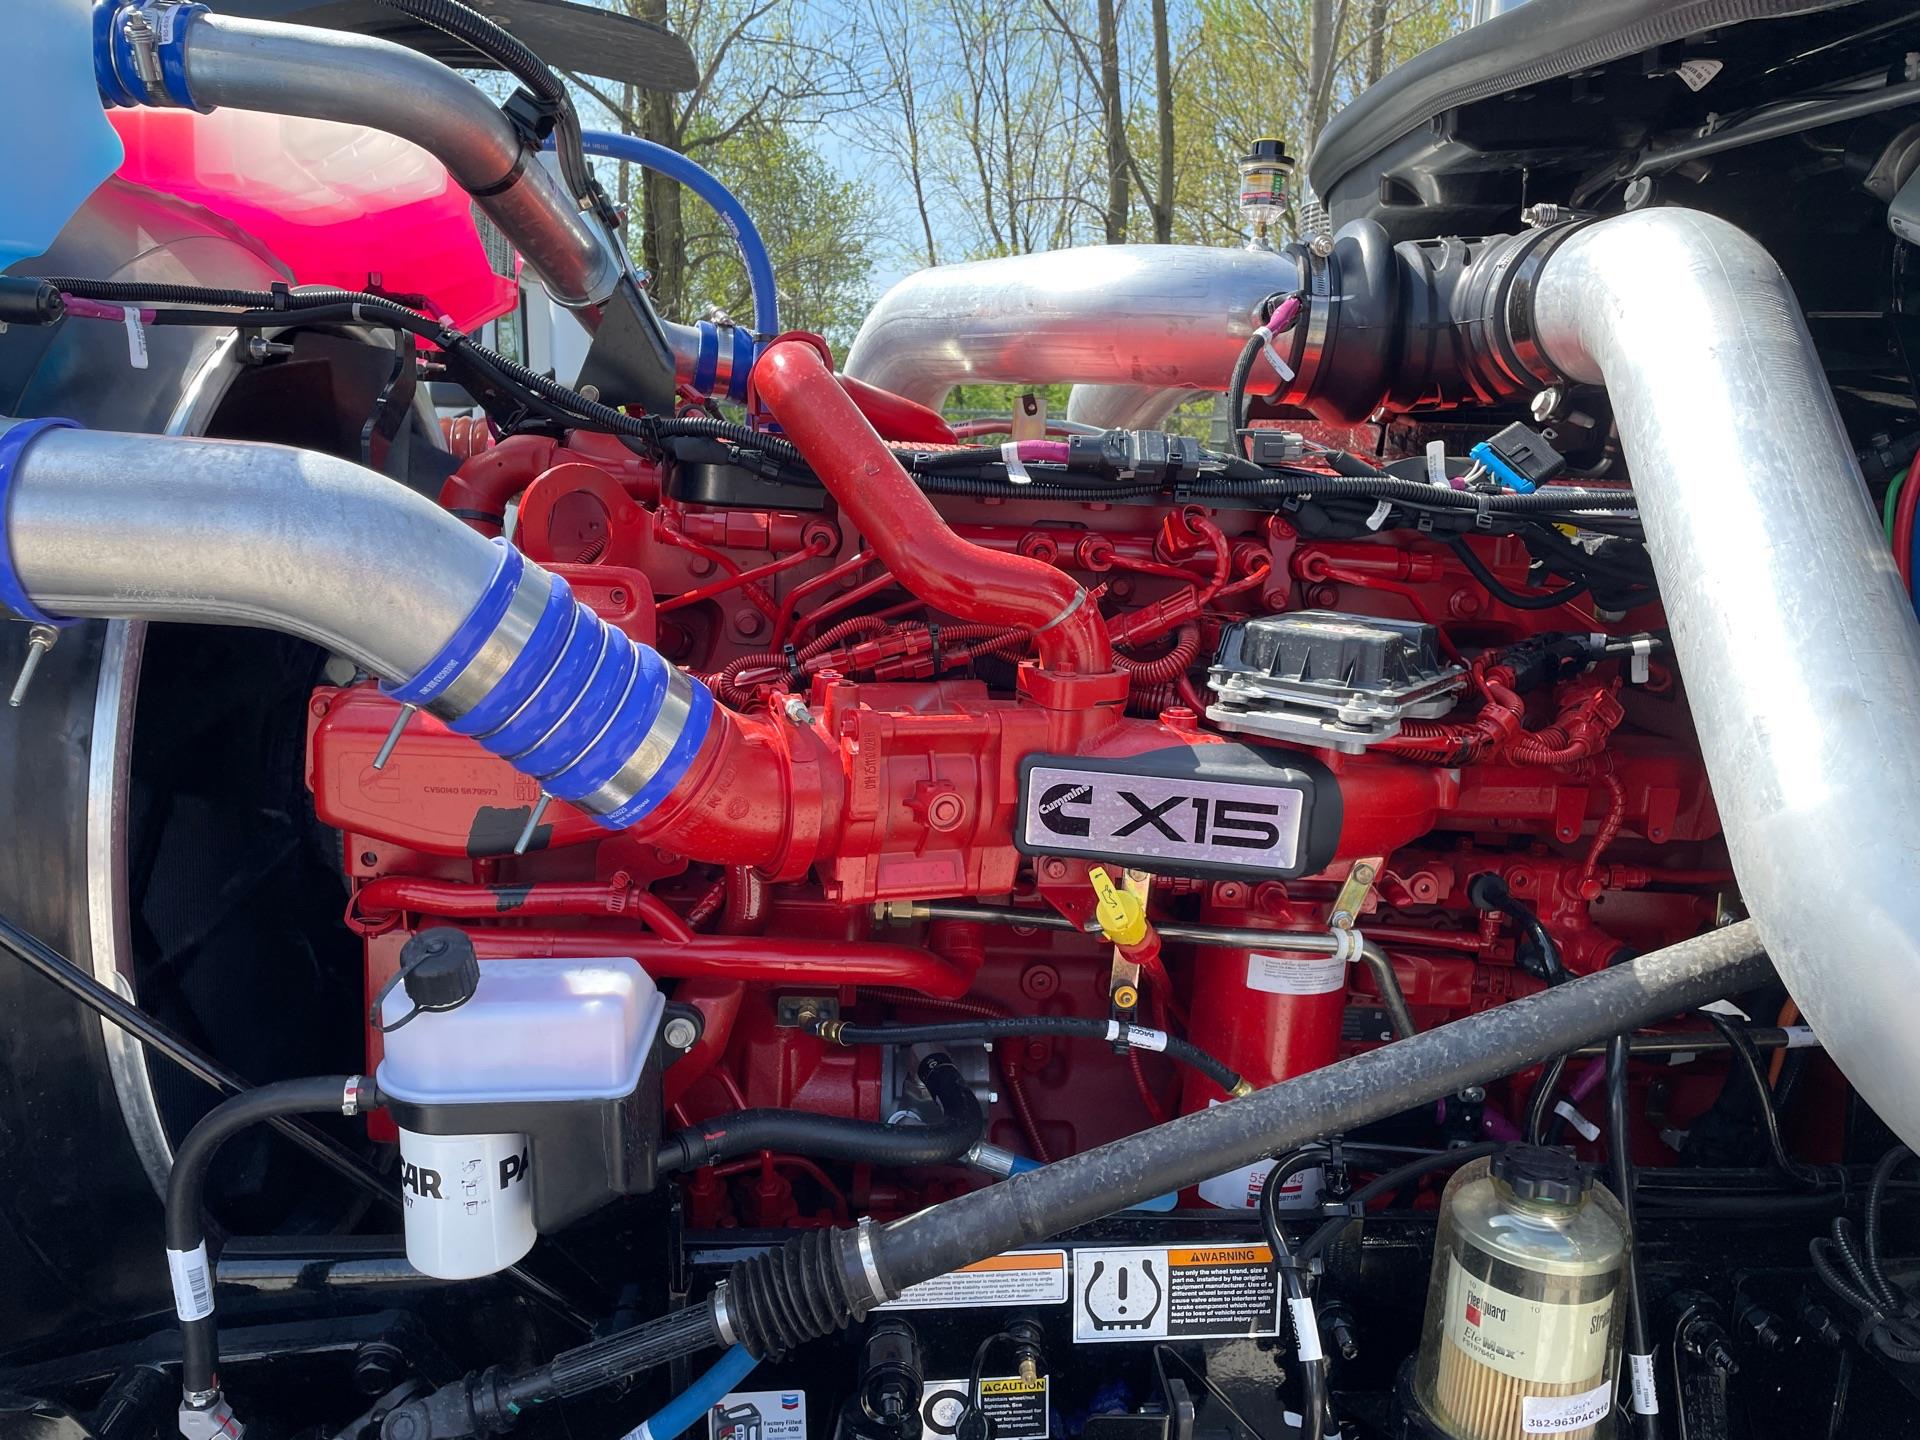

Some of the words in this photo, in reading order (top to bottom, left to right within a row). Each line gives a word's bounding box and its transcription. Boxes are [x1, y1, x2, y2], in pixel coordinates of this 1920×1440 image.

[1039, 784, 1091, 815] Cummins
[1111, 791, 1280, 850] X15
[1200, 1251, 1255, 1261] WARNING
[1185, 1269, 1199, 1277] only
[1467, 1290, 1507, 1322] Fleetguard
